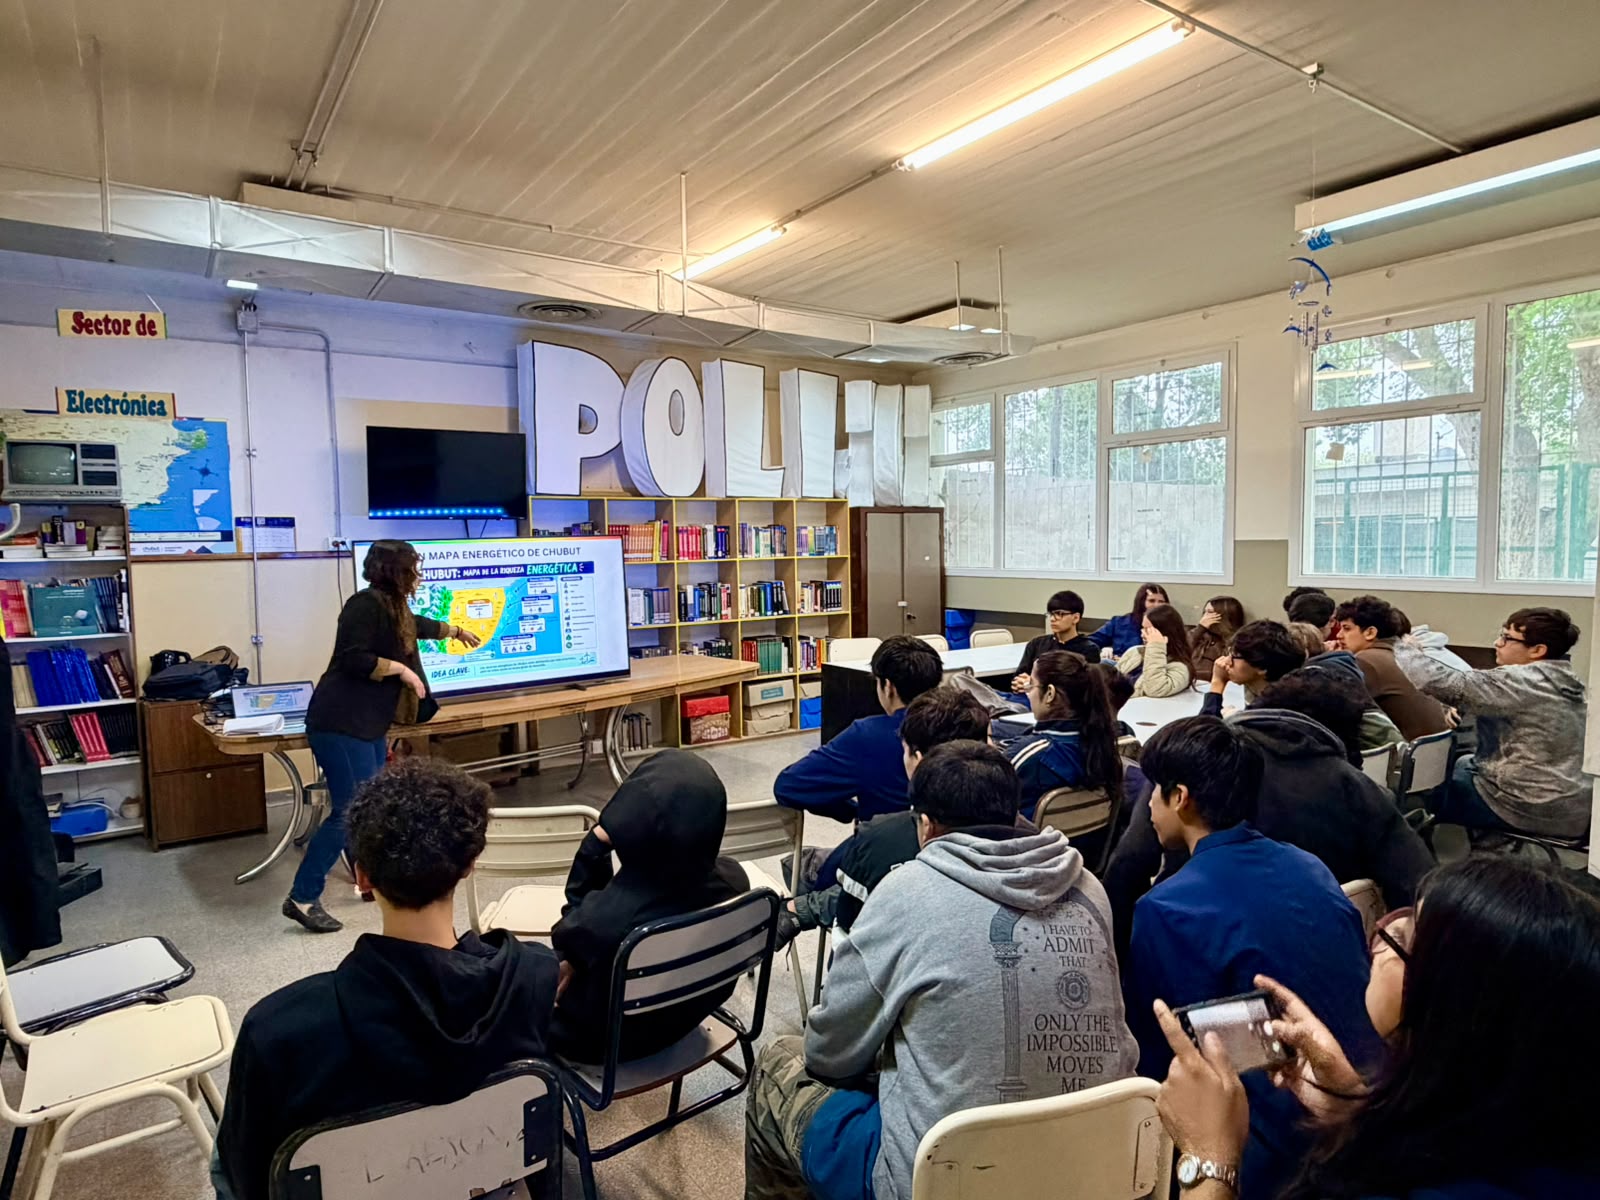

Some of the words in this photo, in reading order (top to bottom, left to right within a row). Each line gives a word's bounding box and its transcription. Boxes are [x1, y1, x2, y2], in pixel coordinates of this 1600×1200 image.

[71, 311, 131, 336] Sector
[135, 313, 158, 336] de
[65, 389, 167, 416] Electrónica
[428, 551, 460, 560] MAPA
[462, 547, 525, 559] ENERGÉTICO
[527, 548, 541, 557] DE
[542, 547, 581, 556] CHUBUT
[463, 568, 480, 576] MAPA
[490, 567, 499, 575] LA
[527, 561, 578, 575] ENERGÉTICA
[431, 669, 447, 679] IDEA
[1049, 924, 1077, 936] HAVE
[1078, 925, 1092, 936] TO
[1043, 936, 1095, 954] ADMIT
[1059, 955, 1087, 967] THAT
[1034, 1013, 1082, 1032] ONLY
[1083, 1013, 1111, 1032] THE
[1027, 1034, 1119, 1054] IMPOSSIBLE
[1046, 1055, 1104, 1074] MOVES
[1061, 1076, 1088, 1094] ME
